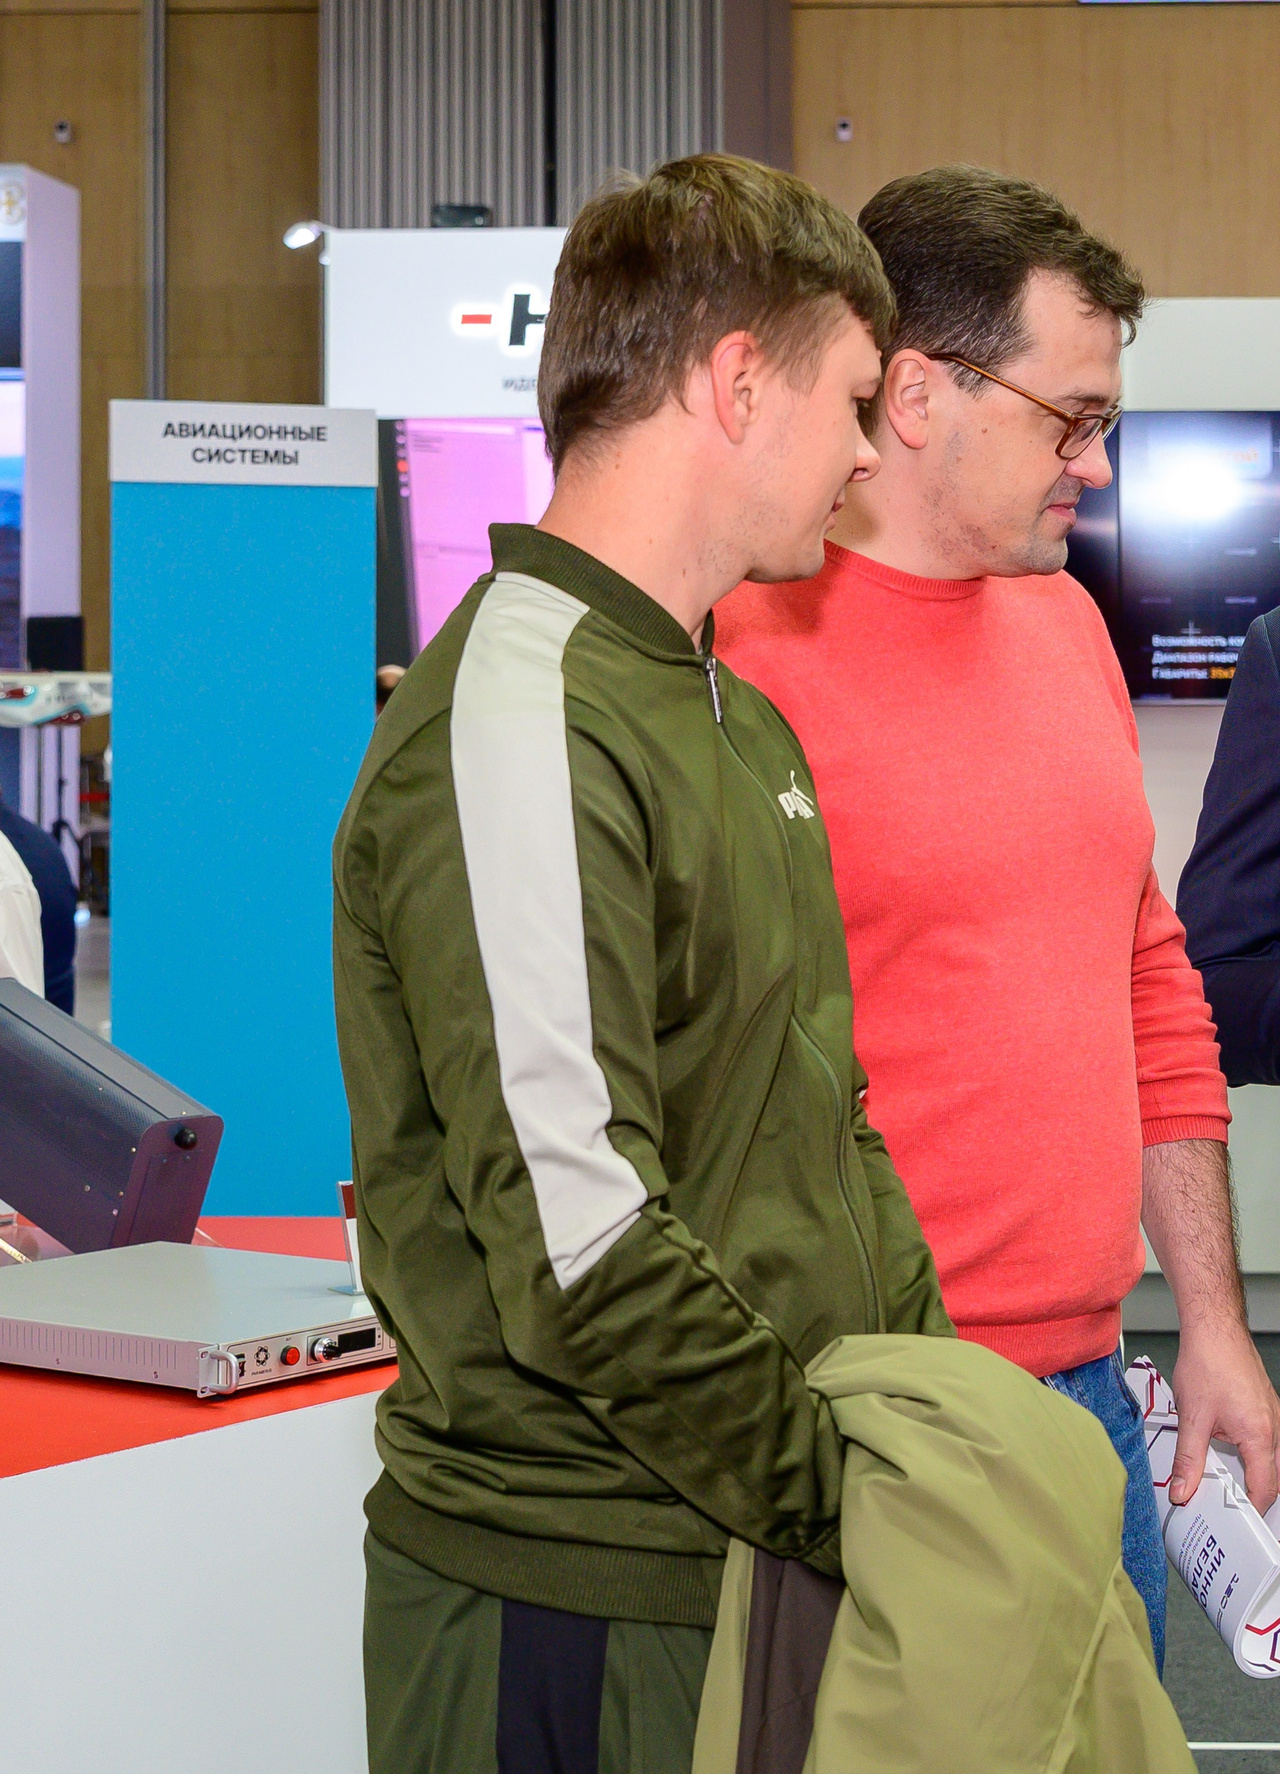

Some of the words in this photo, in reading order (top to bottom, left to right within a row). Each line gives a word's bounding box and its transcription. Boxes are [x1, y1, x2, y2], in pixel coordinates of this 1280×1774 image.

[163, 423, 328, 442] АВИАЦИОННЫЕ
[192, 448, 299, 465] СИСТЕМЫ
[1192, 1525, 1209, 1554] Каталог
